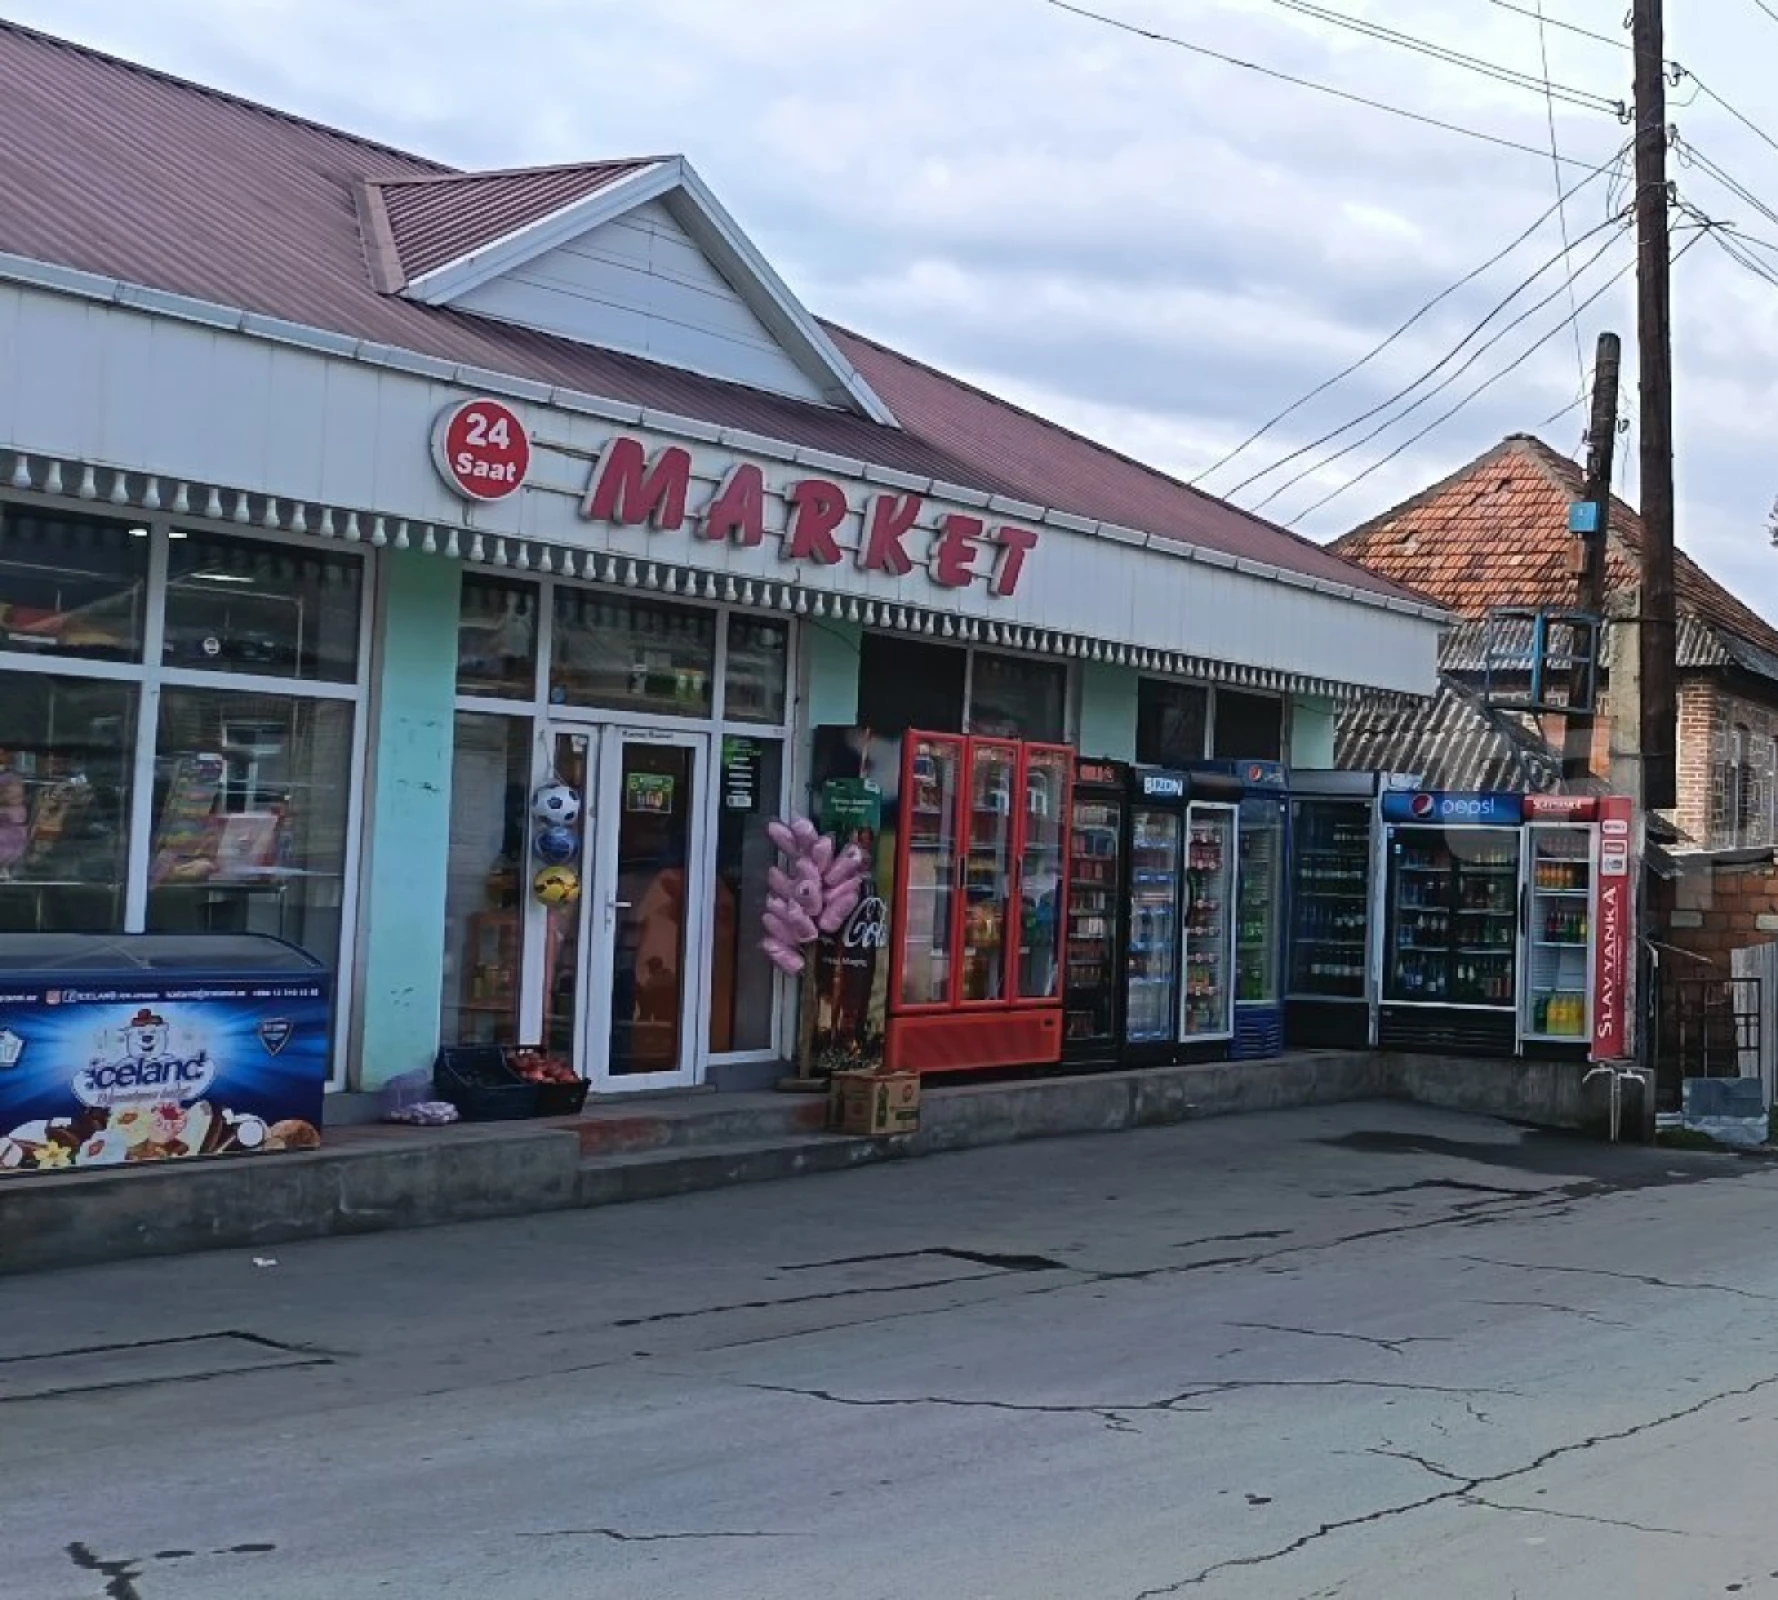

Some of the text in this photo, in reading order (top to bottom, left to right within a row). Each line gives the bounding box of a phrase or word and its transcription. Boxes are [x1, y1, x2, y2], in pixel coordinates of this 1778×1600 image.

[464, 413, 510, 450] 24
[456, 452, 517, 484] Saat
[583, 437, 1038, 597] MARKET
[1441, 797, 1494, 816] pepsi
[1597, 886, 1617, 1038] SLAVYANKA
